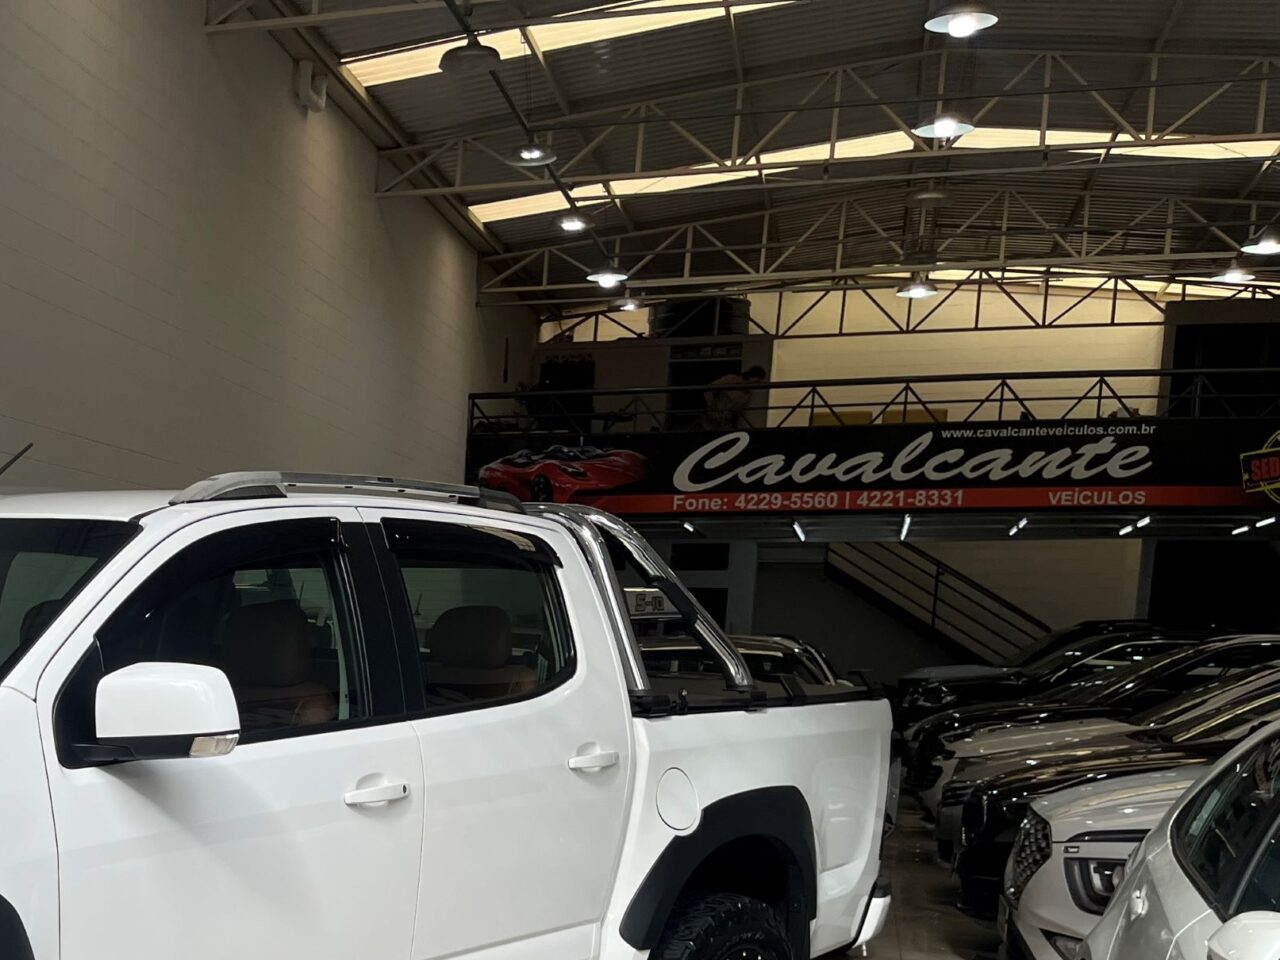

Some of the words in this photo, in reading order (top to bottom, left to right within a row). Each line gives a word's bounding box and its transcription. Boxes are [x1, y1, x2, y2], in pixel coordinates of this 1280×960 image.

[673, 431, 1153, 493] Cavalcante
[672, 494, 728, 511] Fone:
[734, 491, 838, 510] 4229-5560
[856, 488, 964, 507] 4221-8331
[1048, 487, 1146, 506] VEÍCULOS
